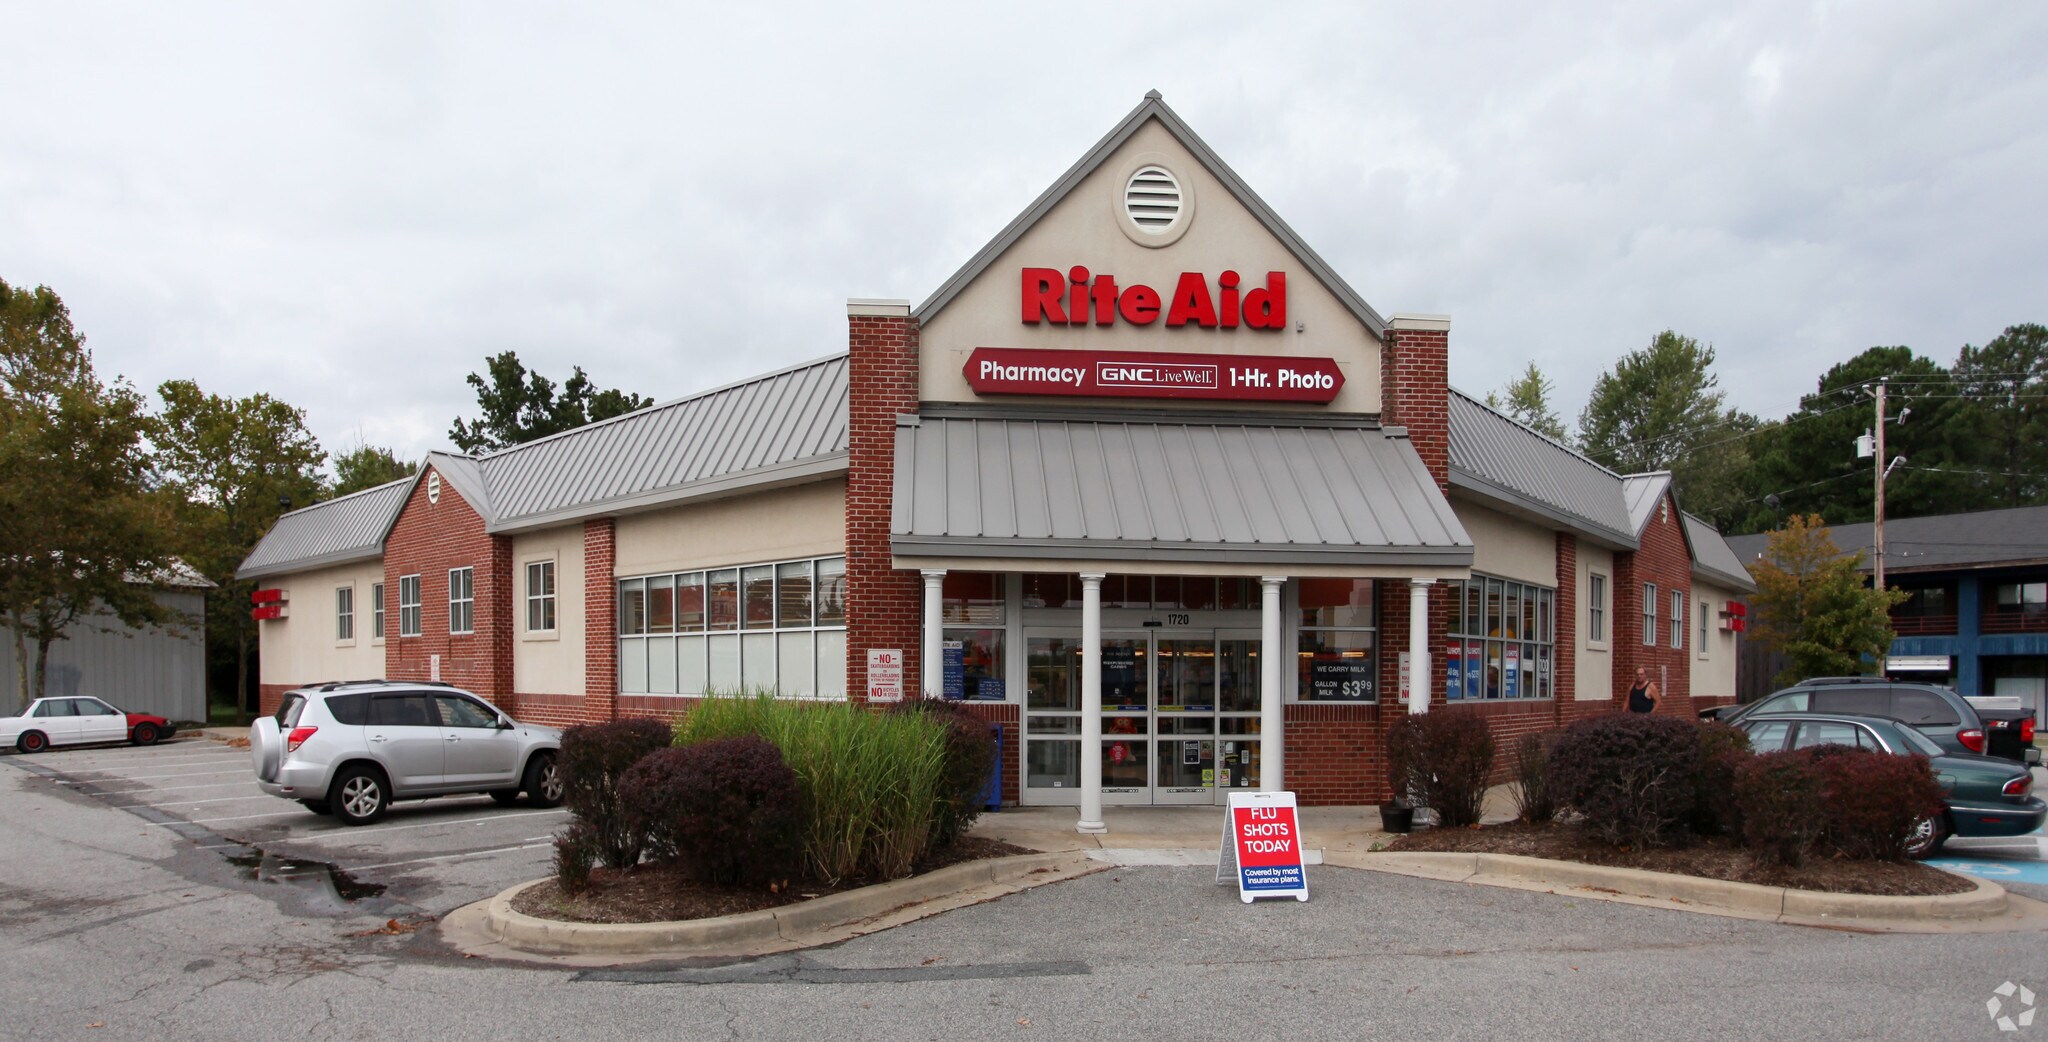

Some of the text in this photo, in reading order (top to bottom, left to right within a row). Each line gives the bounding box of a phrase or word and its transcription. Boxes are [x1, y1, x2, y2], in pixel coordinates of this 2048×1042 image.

[1022, 265, 1286, 330] Rite Aid
[980, 360, 1086, 387] Pharmacy
[1101, 368, 1155, 382] GNC
[1229, 367, 1271, 388] 1-Hr.
[1278, 368, 1334, 389] Photo
[1168, 614, 1189, 625] 1720
[879, 654, 891, 664] NO
[871, 687, 883, 697] NO
[1251, 807, 1277, 820] FLU
[1243, 823, 1289, 837] SHOTS
[1244, 839, 1291, 853] TODAY
[1244, 867, 1299, 877] Covered by most
